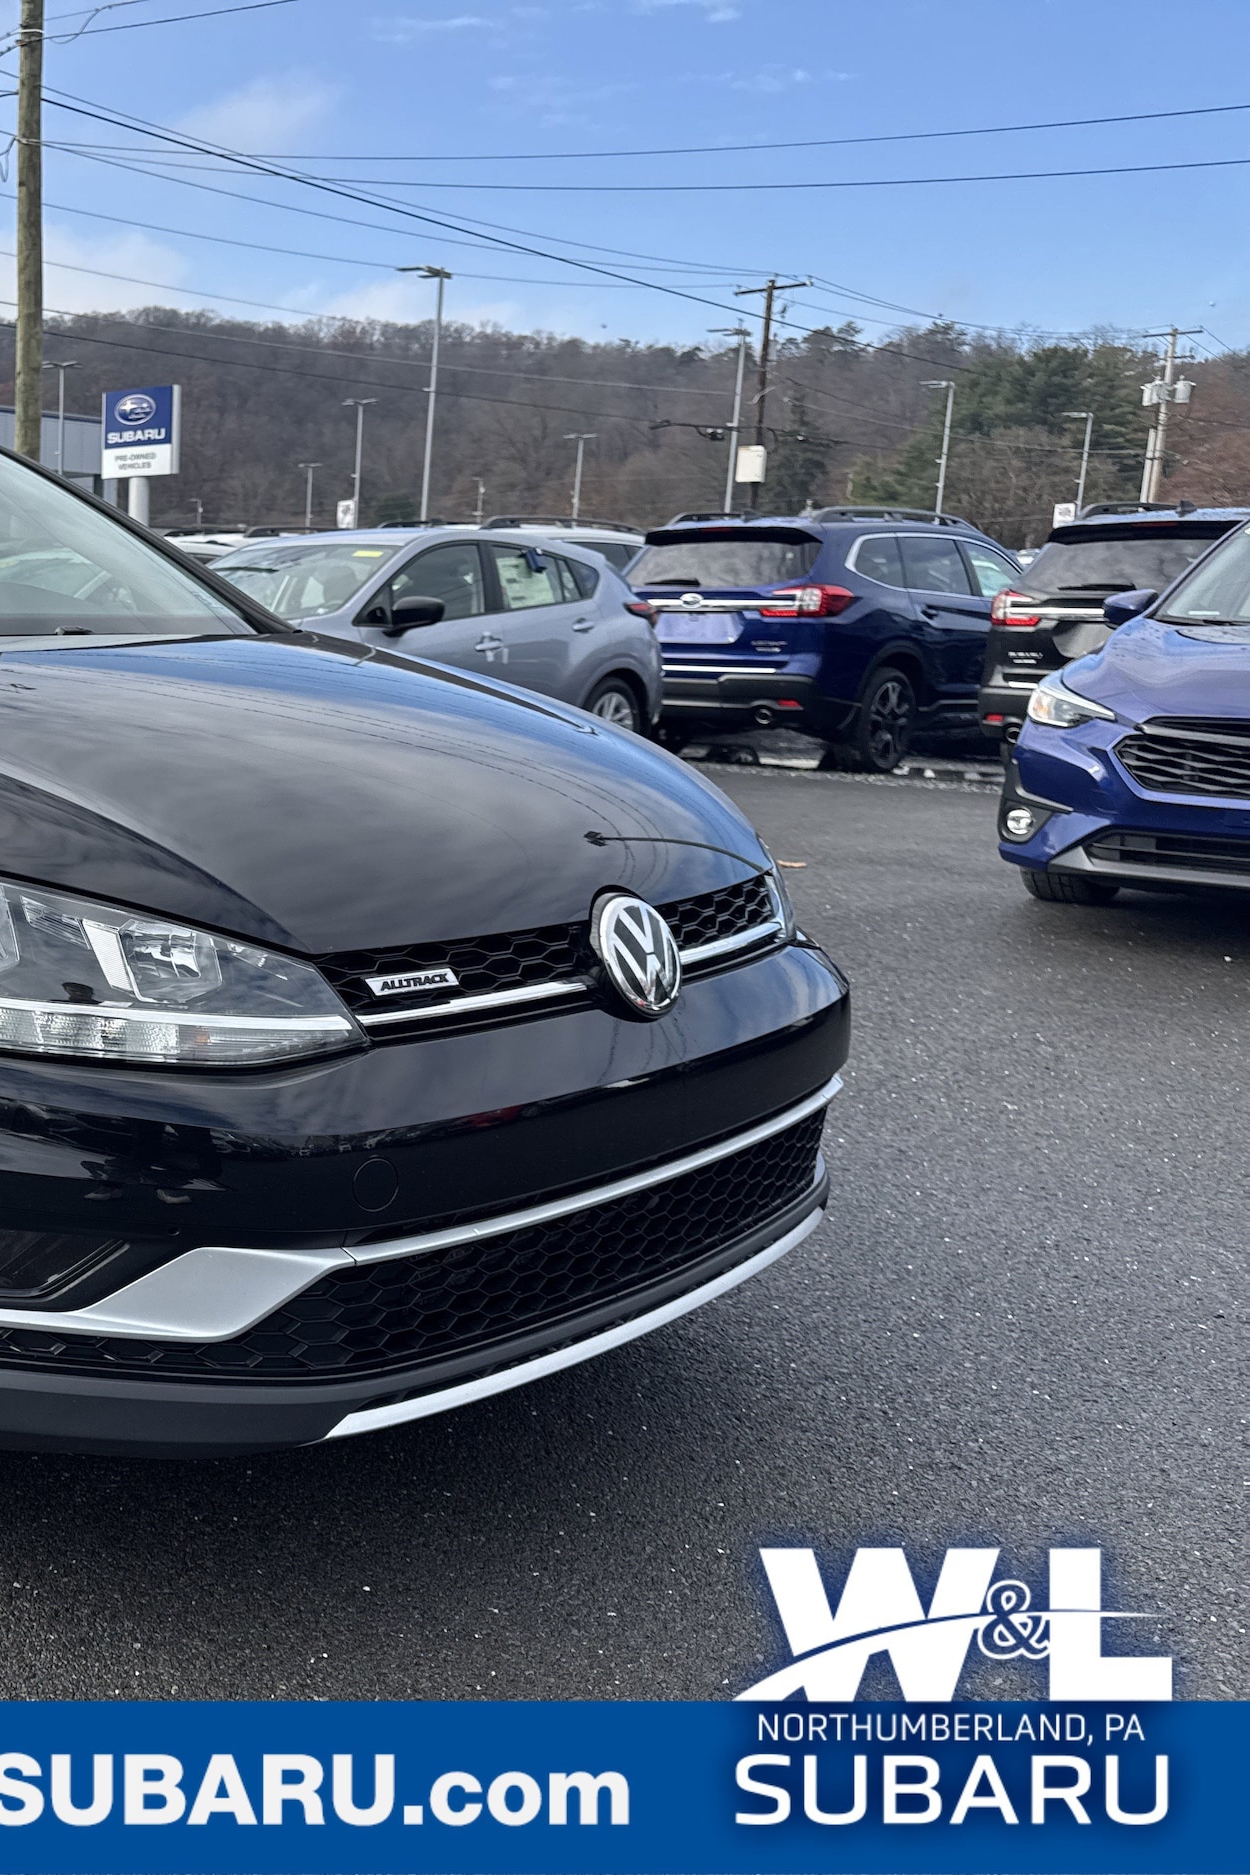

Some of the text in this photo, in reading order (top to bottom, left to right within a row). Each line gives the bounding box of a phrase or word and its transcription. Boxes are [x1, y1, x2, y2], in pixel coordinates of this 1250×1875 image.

[107, 428, 166, 444] SUBARU
[114, 452, 156, 462] PRE-OWNED
[119, 462, 152, 470] VEHICLES
[380, 972, 450, 991] ALLTRACK
